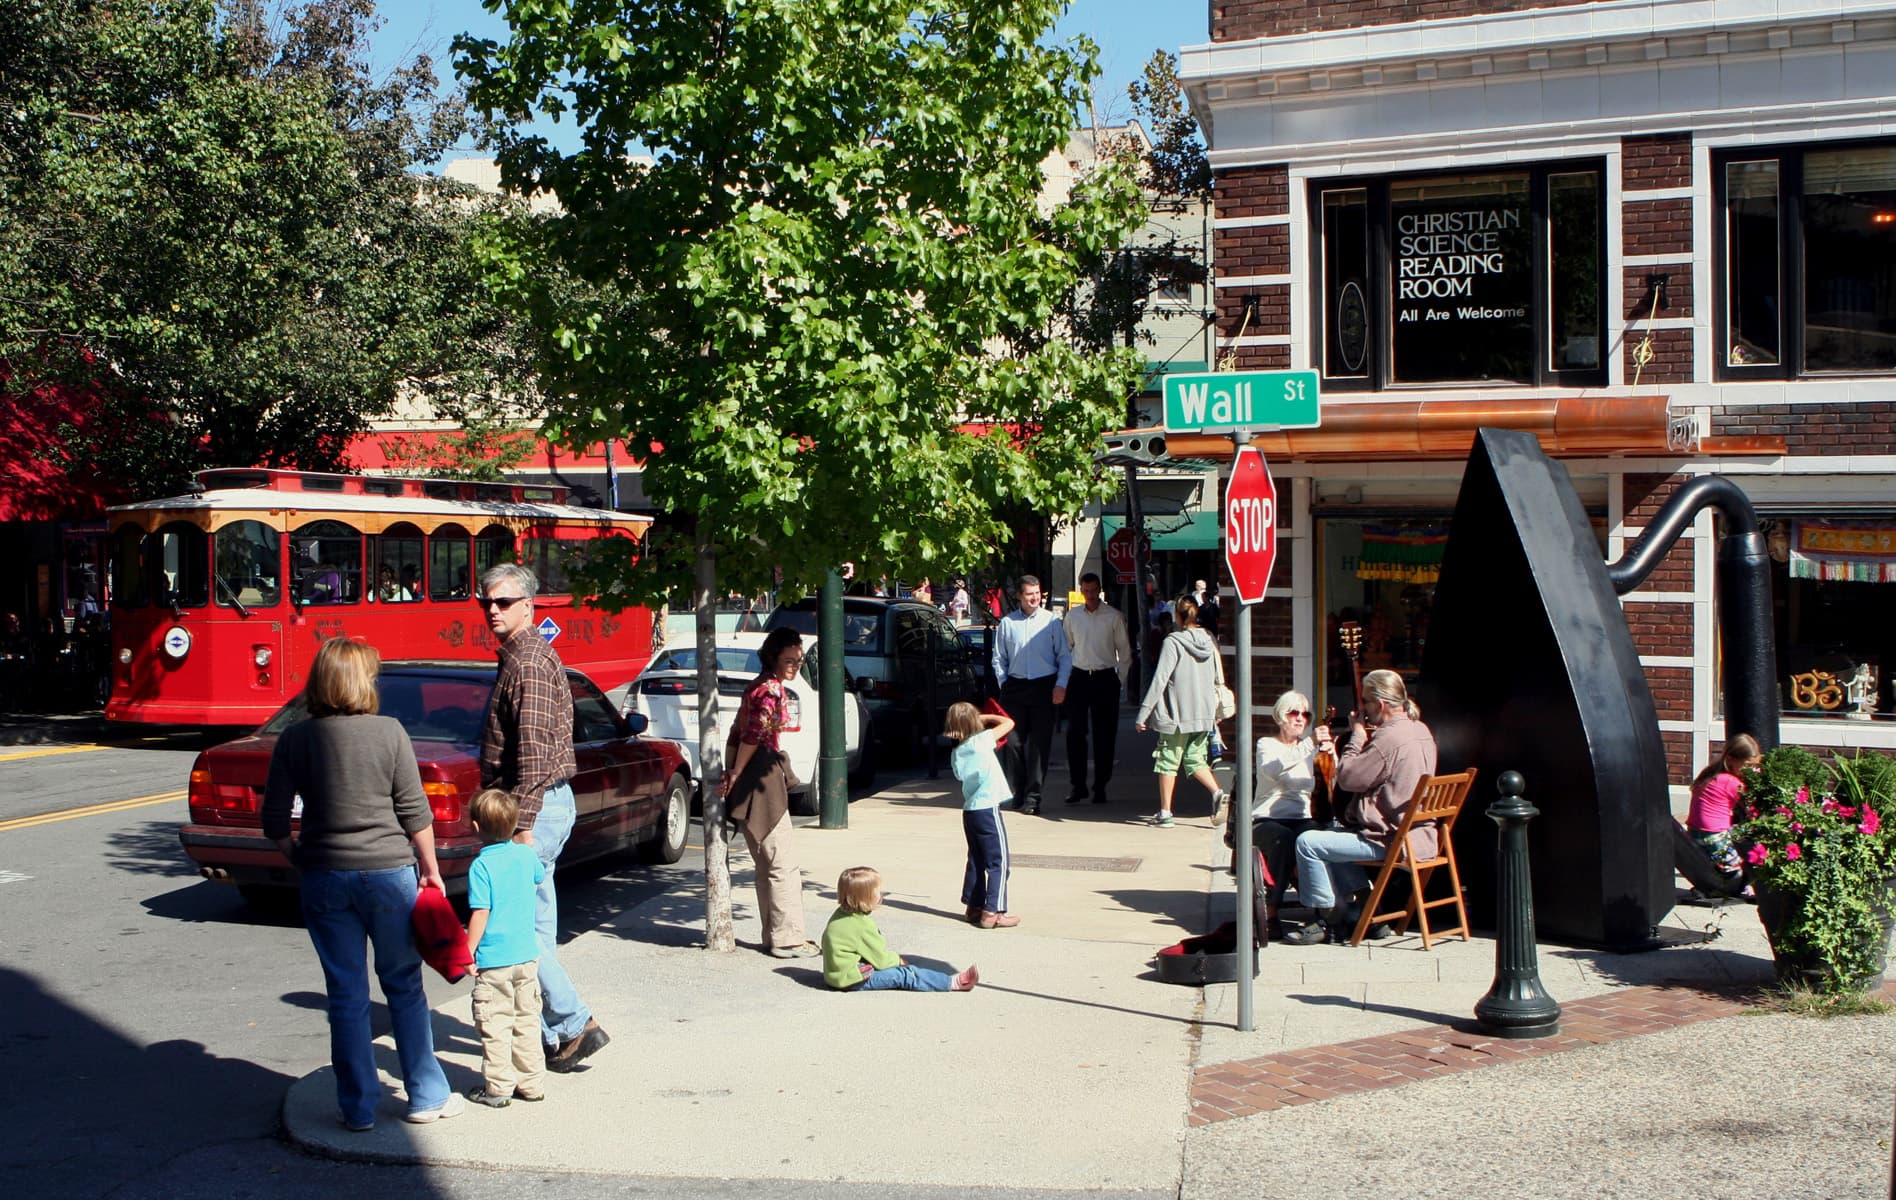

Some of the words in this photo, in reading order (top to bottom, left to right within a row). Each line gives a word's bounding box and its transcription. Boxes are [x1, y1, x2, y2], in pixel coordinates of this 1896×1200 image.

[1398, 209, 1521, 234] CHRISTIAN
[1399, 231, 1500, 256] SCIENCE
[1399, 253, 1504, 277] READING
[1399, 277, 1472, 299] ROOM
[1400, 309, 1418, 322] All
[1426, 309, 1450, 321] Are
[1457, 306, 1525, 319] Welcome
[1178, 381, 1252, 424] Wall
[1284, 379, 1305, 401] St
[1229, 497, 1273, 554] STOP
